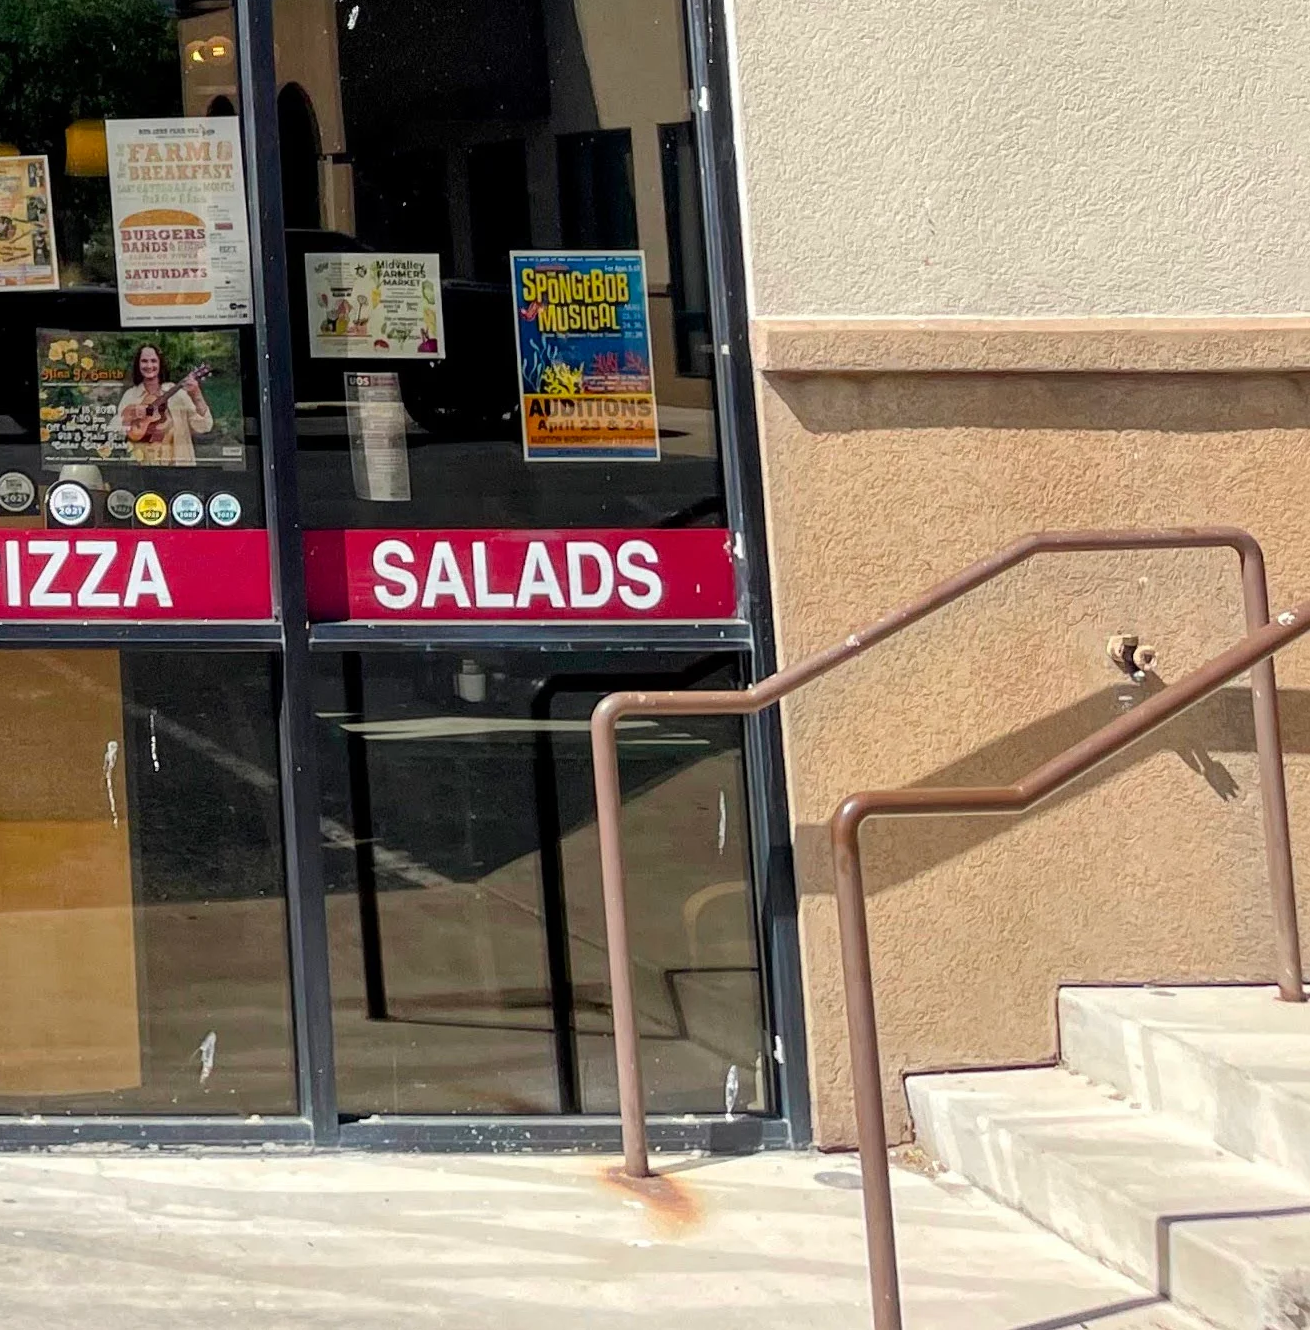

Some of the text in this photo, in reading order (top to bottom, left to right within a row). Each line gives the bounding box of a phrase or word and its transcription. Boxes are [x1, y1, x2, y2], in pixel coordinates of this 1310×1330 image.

[127, 142, 212, 163] FARM
[128, 164, 234, 181] BREAKFAST
[121, 228, 206, 241] BURGERS
[122, 241, 169, 253] BANDS
[376, 260, 425, 272] Midvalley
[125, 268, 208, 280] SATURDAYS
[377, 271, 427, 279] FARMERS
[382, 279, 421, 287] MARKET
[521, 268, 629, 304] SPONGEBOB
[538, 303, 621, 332] MUSICAL
[529, 399, 652, 418] AUDITIONS
[538, 419, 575, 433] April
[607, 419, 620, 430] &
[624, 419, 645, 430] 24
[3, 494, 28, 503] 2021
[58, 507, 83, 516] 2021
[372, 539, 663, 610] SALADS
